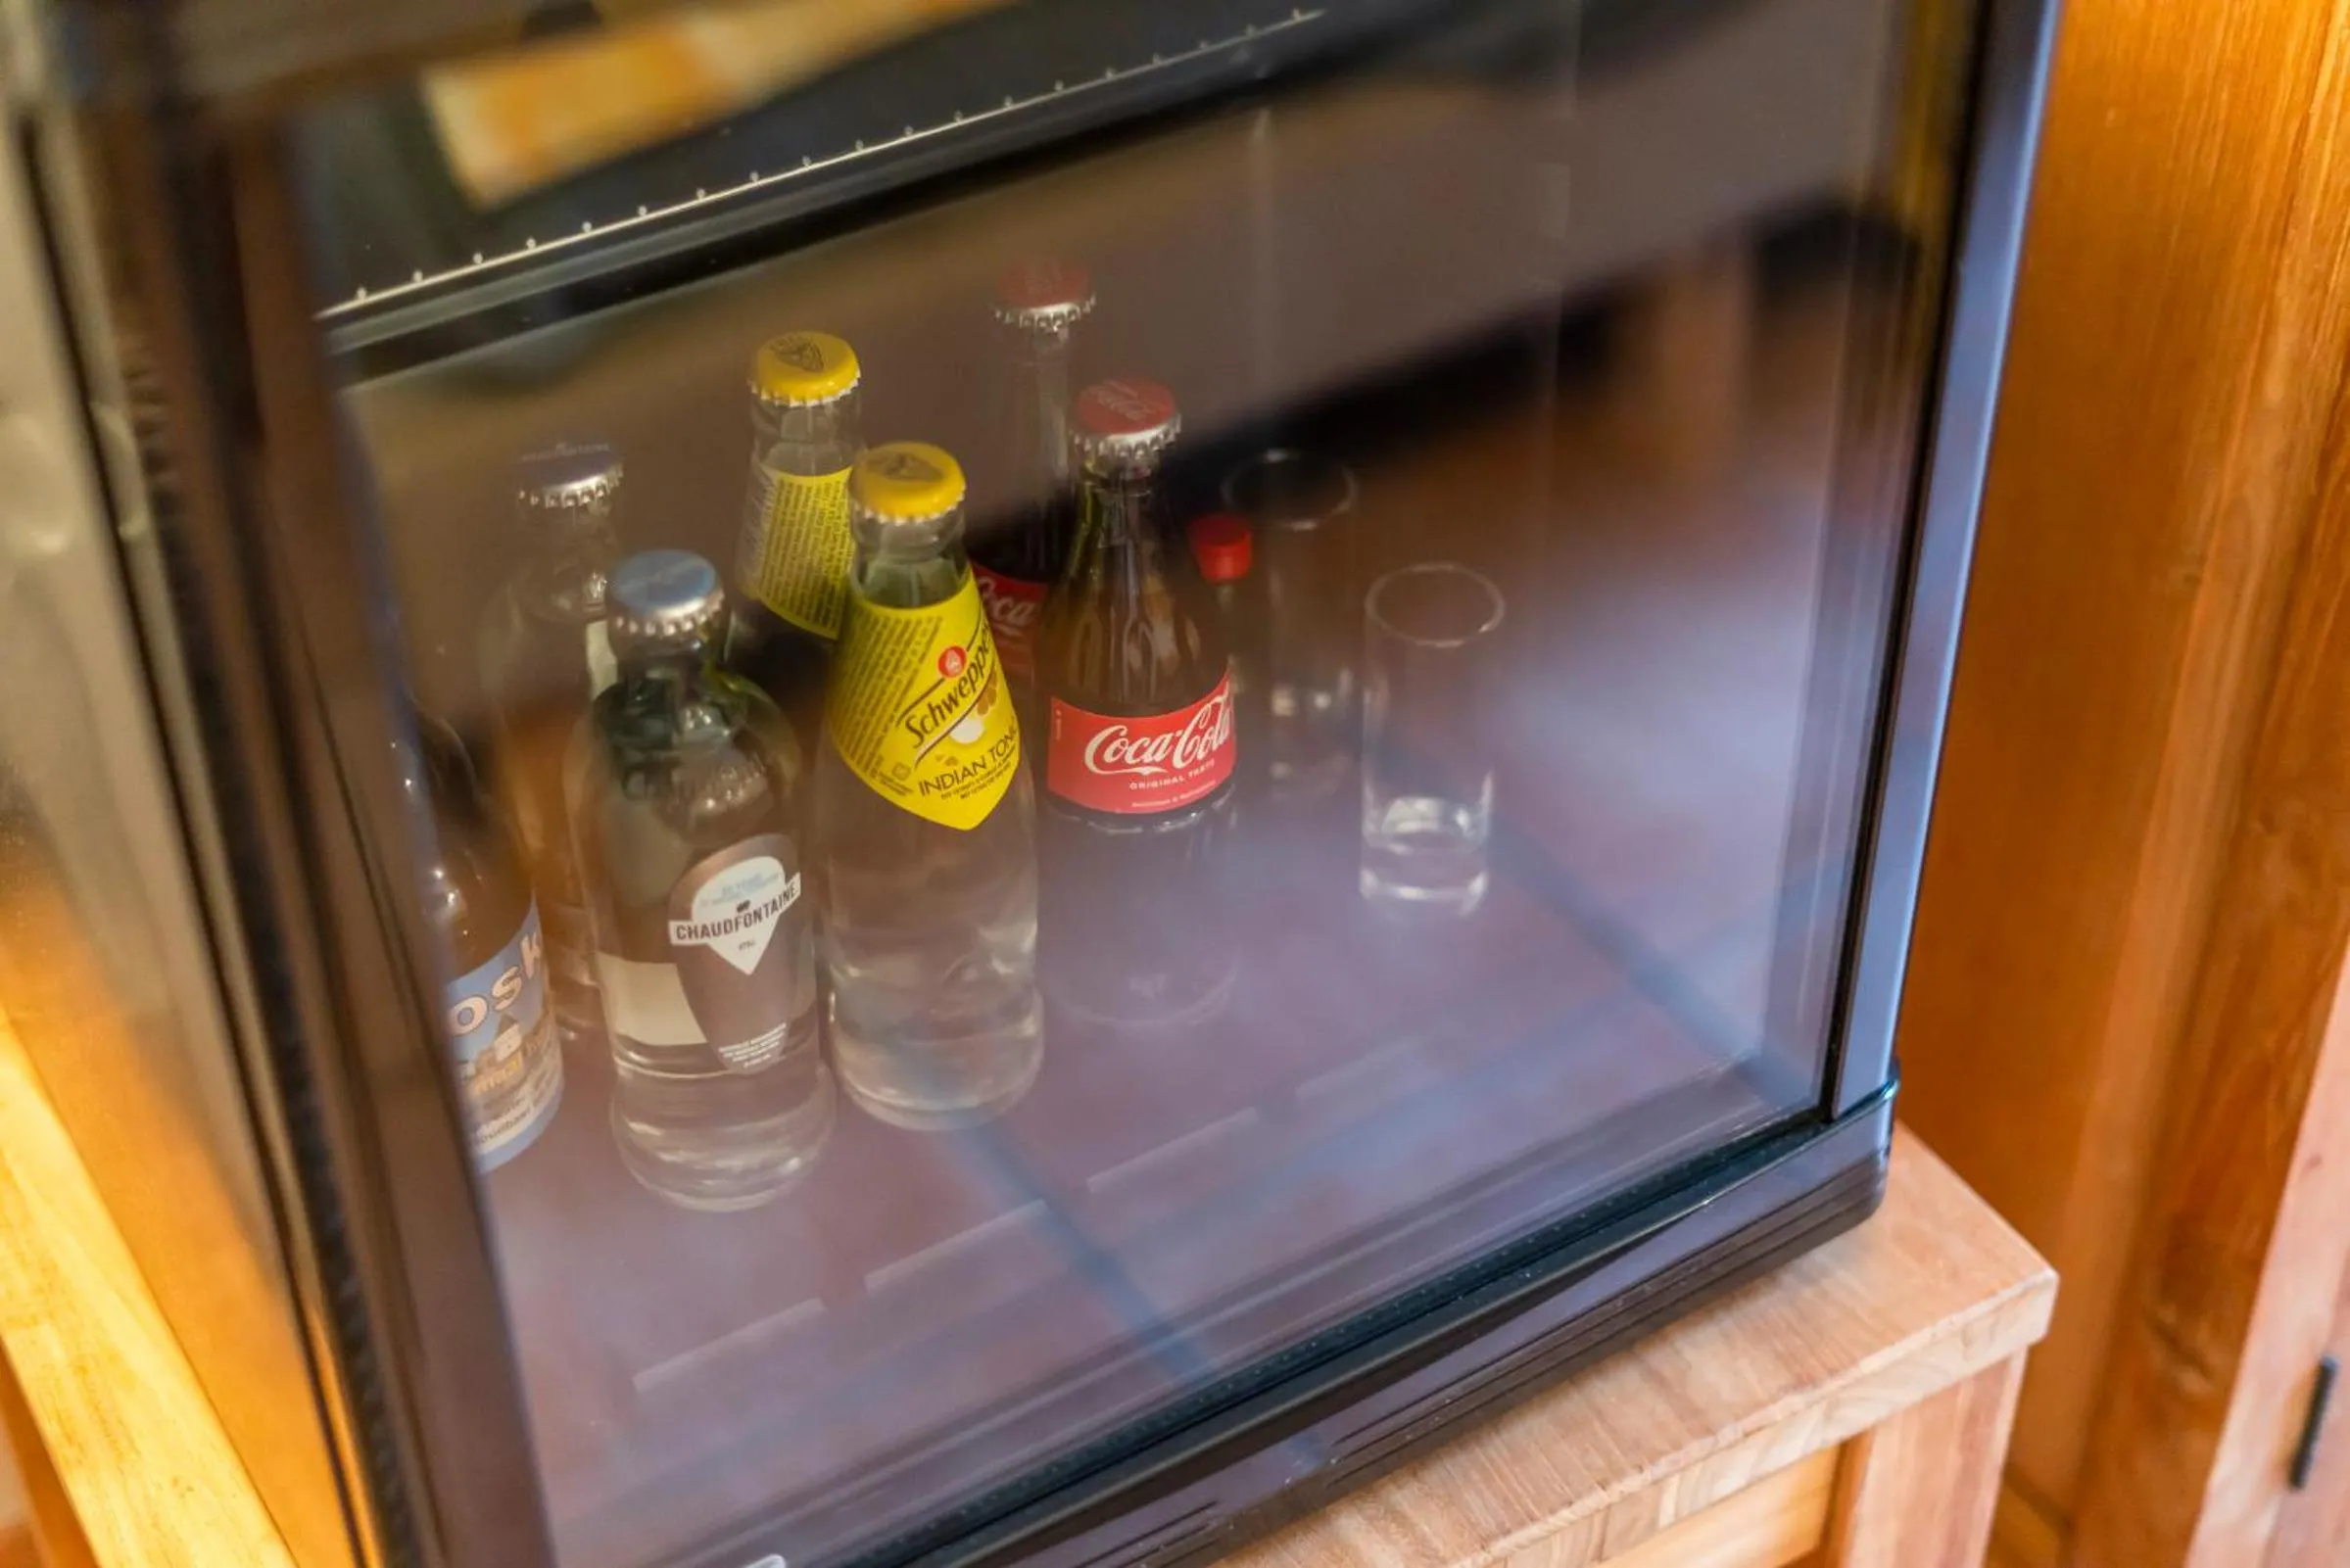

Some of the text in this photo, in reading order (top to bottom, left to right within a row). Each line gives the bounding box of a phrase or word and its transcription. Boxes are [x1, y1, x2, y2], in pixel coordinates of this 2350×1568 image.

[1084, 681, 1230, 776] Coca-Cola
[918, 755, 987, 797] INDIAN
[1129, 776, 1184, 791] ORIGINAL
[676, 882, 796, 941] CHAUDFONTAINE
